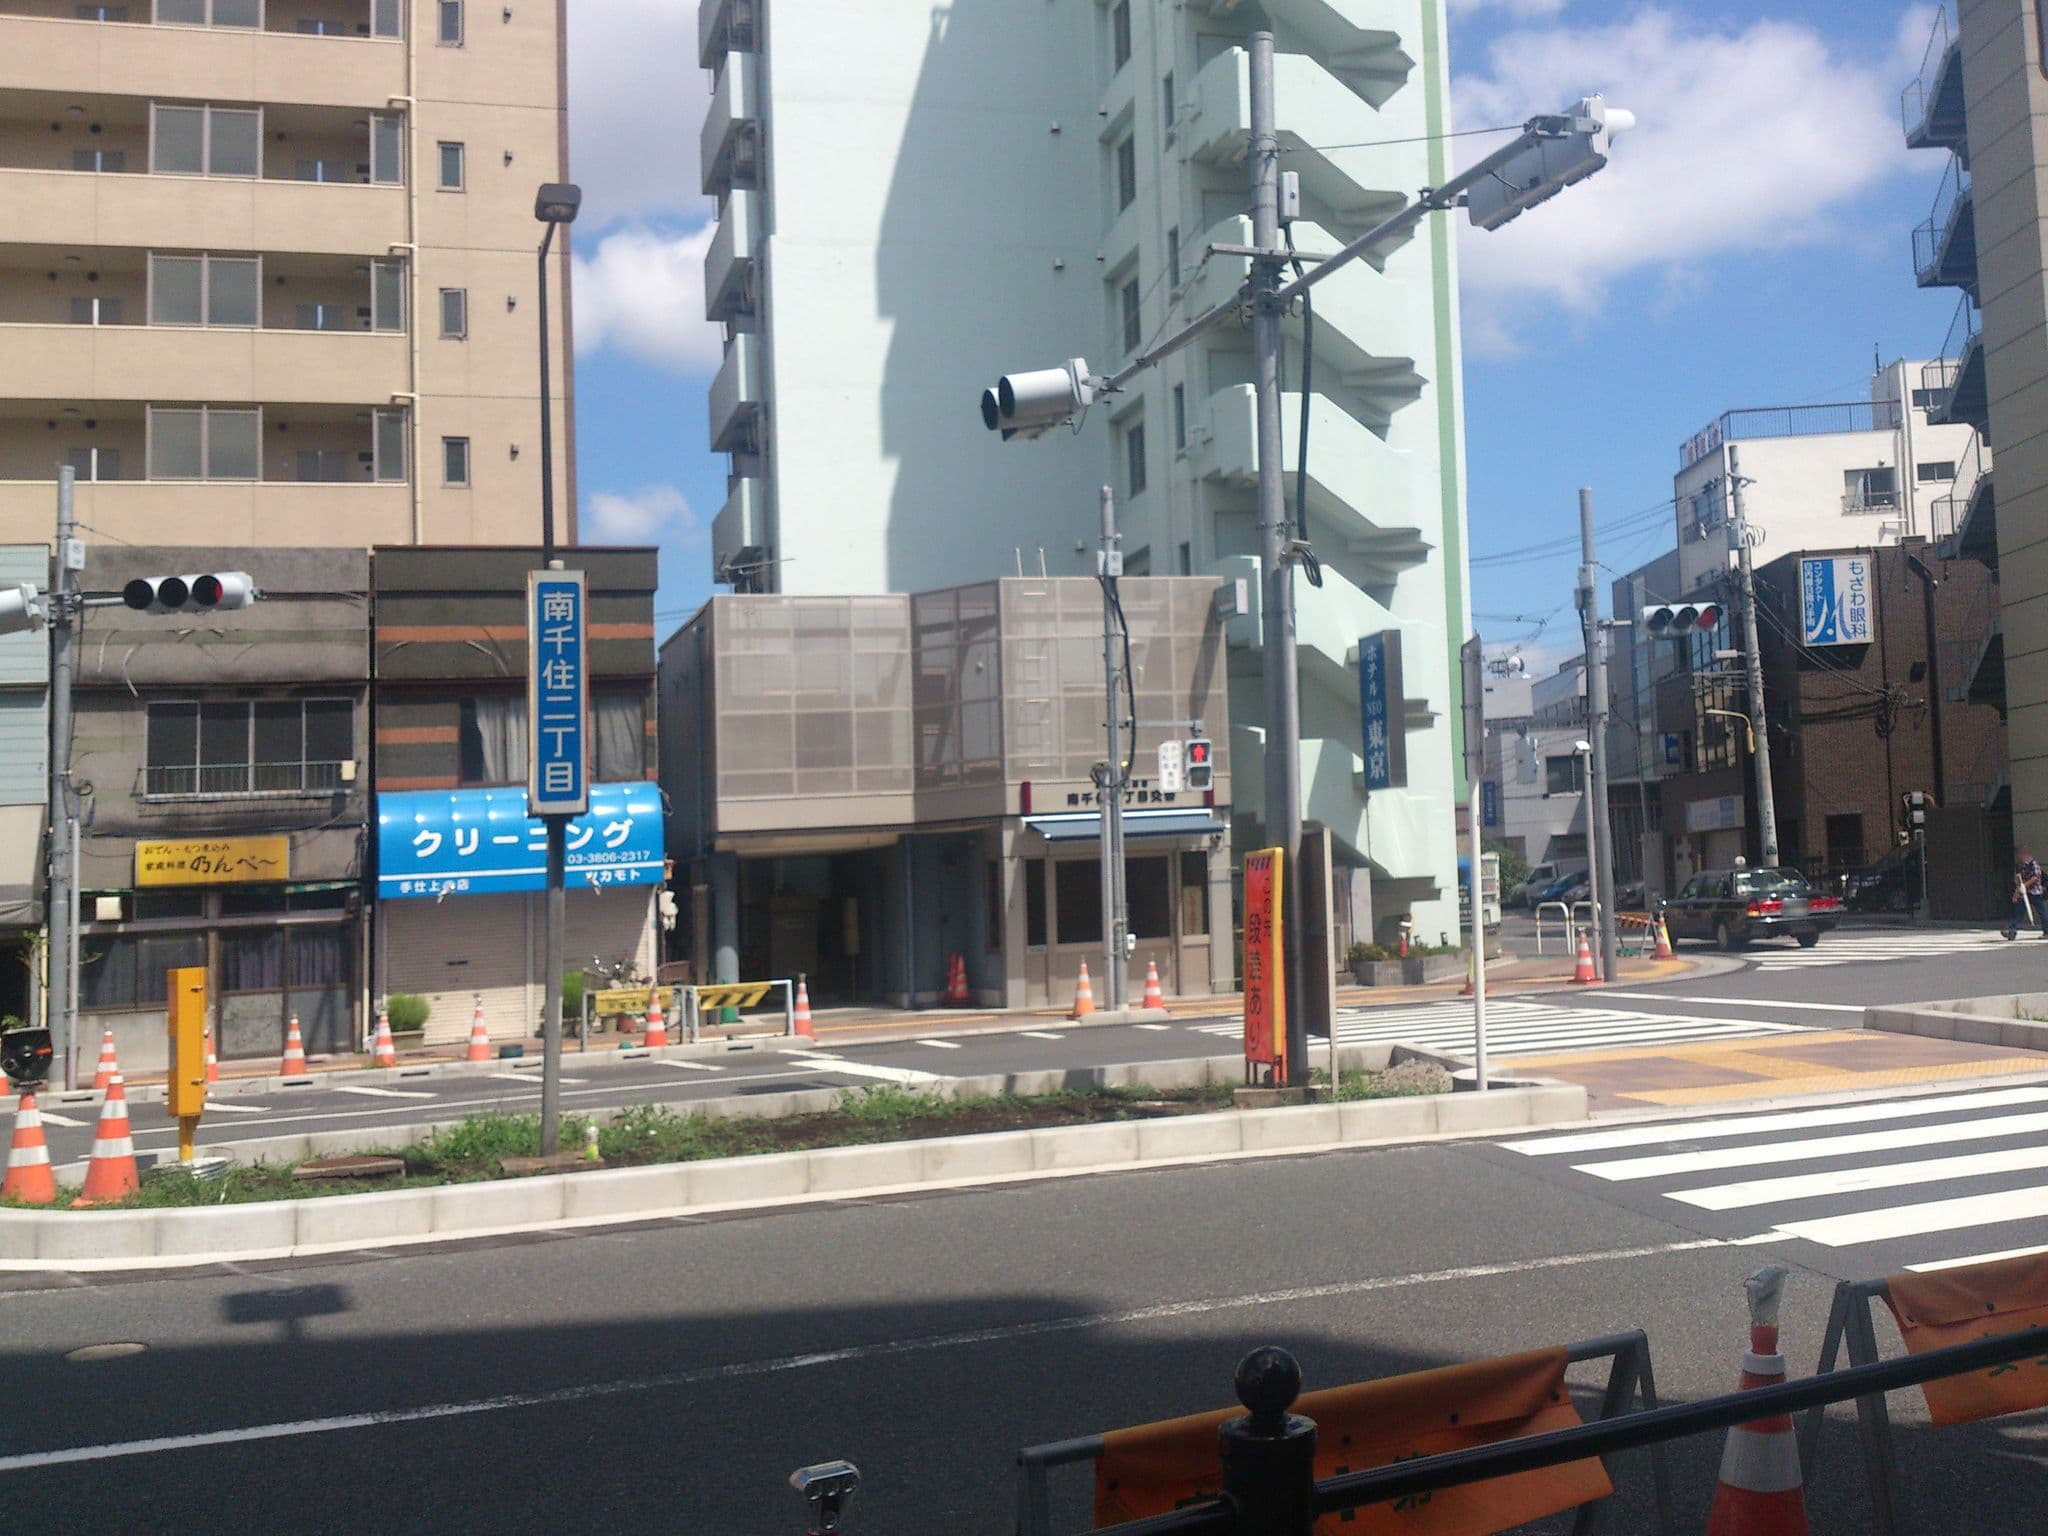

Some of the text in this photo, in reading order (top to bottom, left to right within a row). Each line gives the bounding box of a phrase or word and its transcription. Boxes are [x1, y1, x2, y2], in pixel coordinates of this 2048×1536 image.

[1814, 562, 1823, 602] コンタクト
[1849, 561, 1866, 638] もざわ眼科
[542, 591, 576, 793] 南千住二丁目
[413, 818, 634, 858] クリーニング
[567, 851, 650, 864] 03-3806-2317
[1263, 877, 1271, 937] この先
[1249, 912, 1262, 1050] 段差あり
